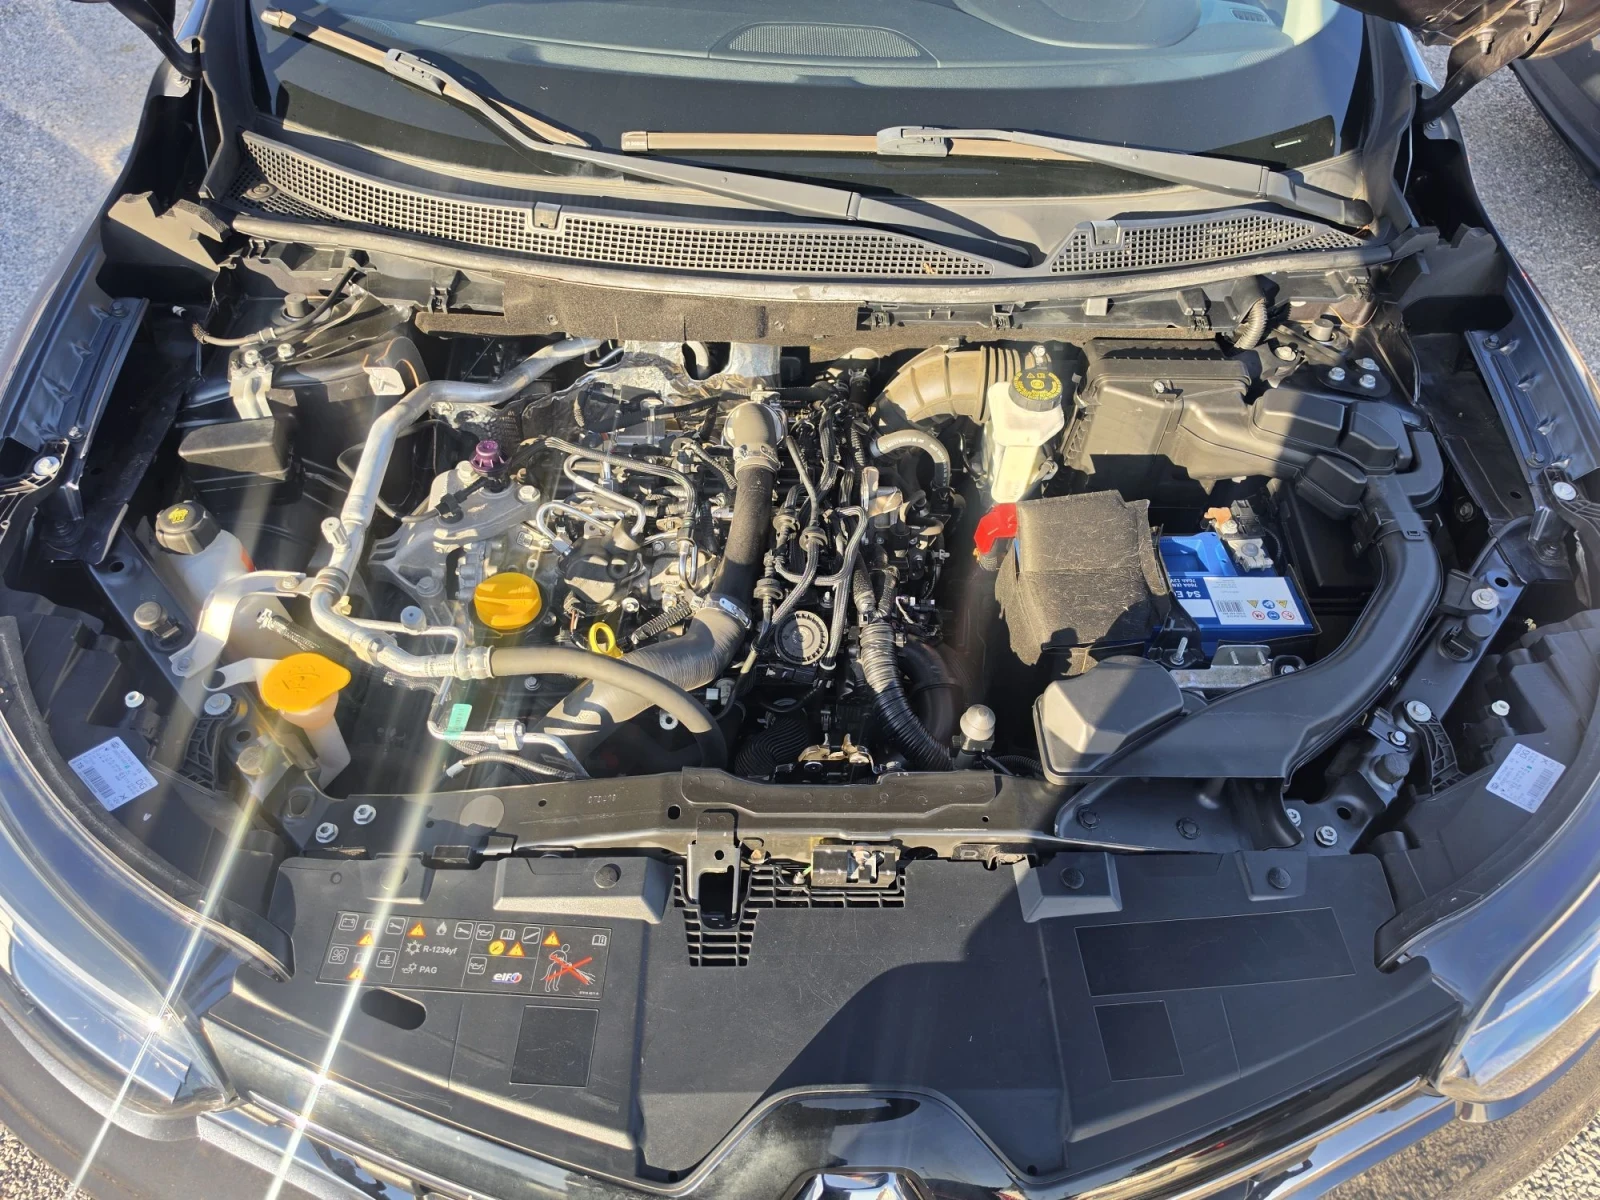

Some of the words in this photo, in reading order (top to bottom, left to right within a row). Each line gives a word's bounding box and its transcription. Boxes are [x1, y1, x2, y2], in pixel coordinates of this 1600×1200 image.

[1186, 590, 1201, 598] S4
[422, 945, 458, 956] R-1234yf
[419, 965, 438, 974] PAG
